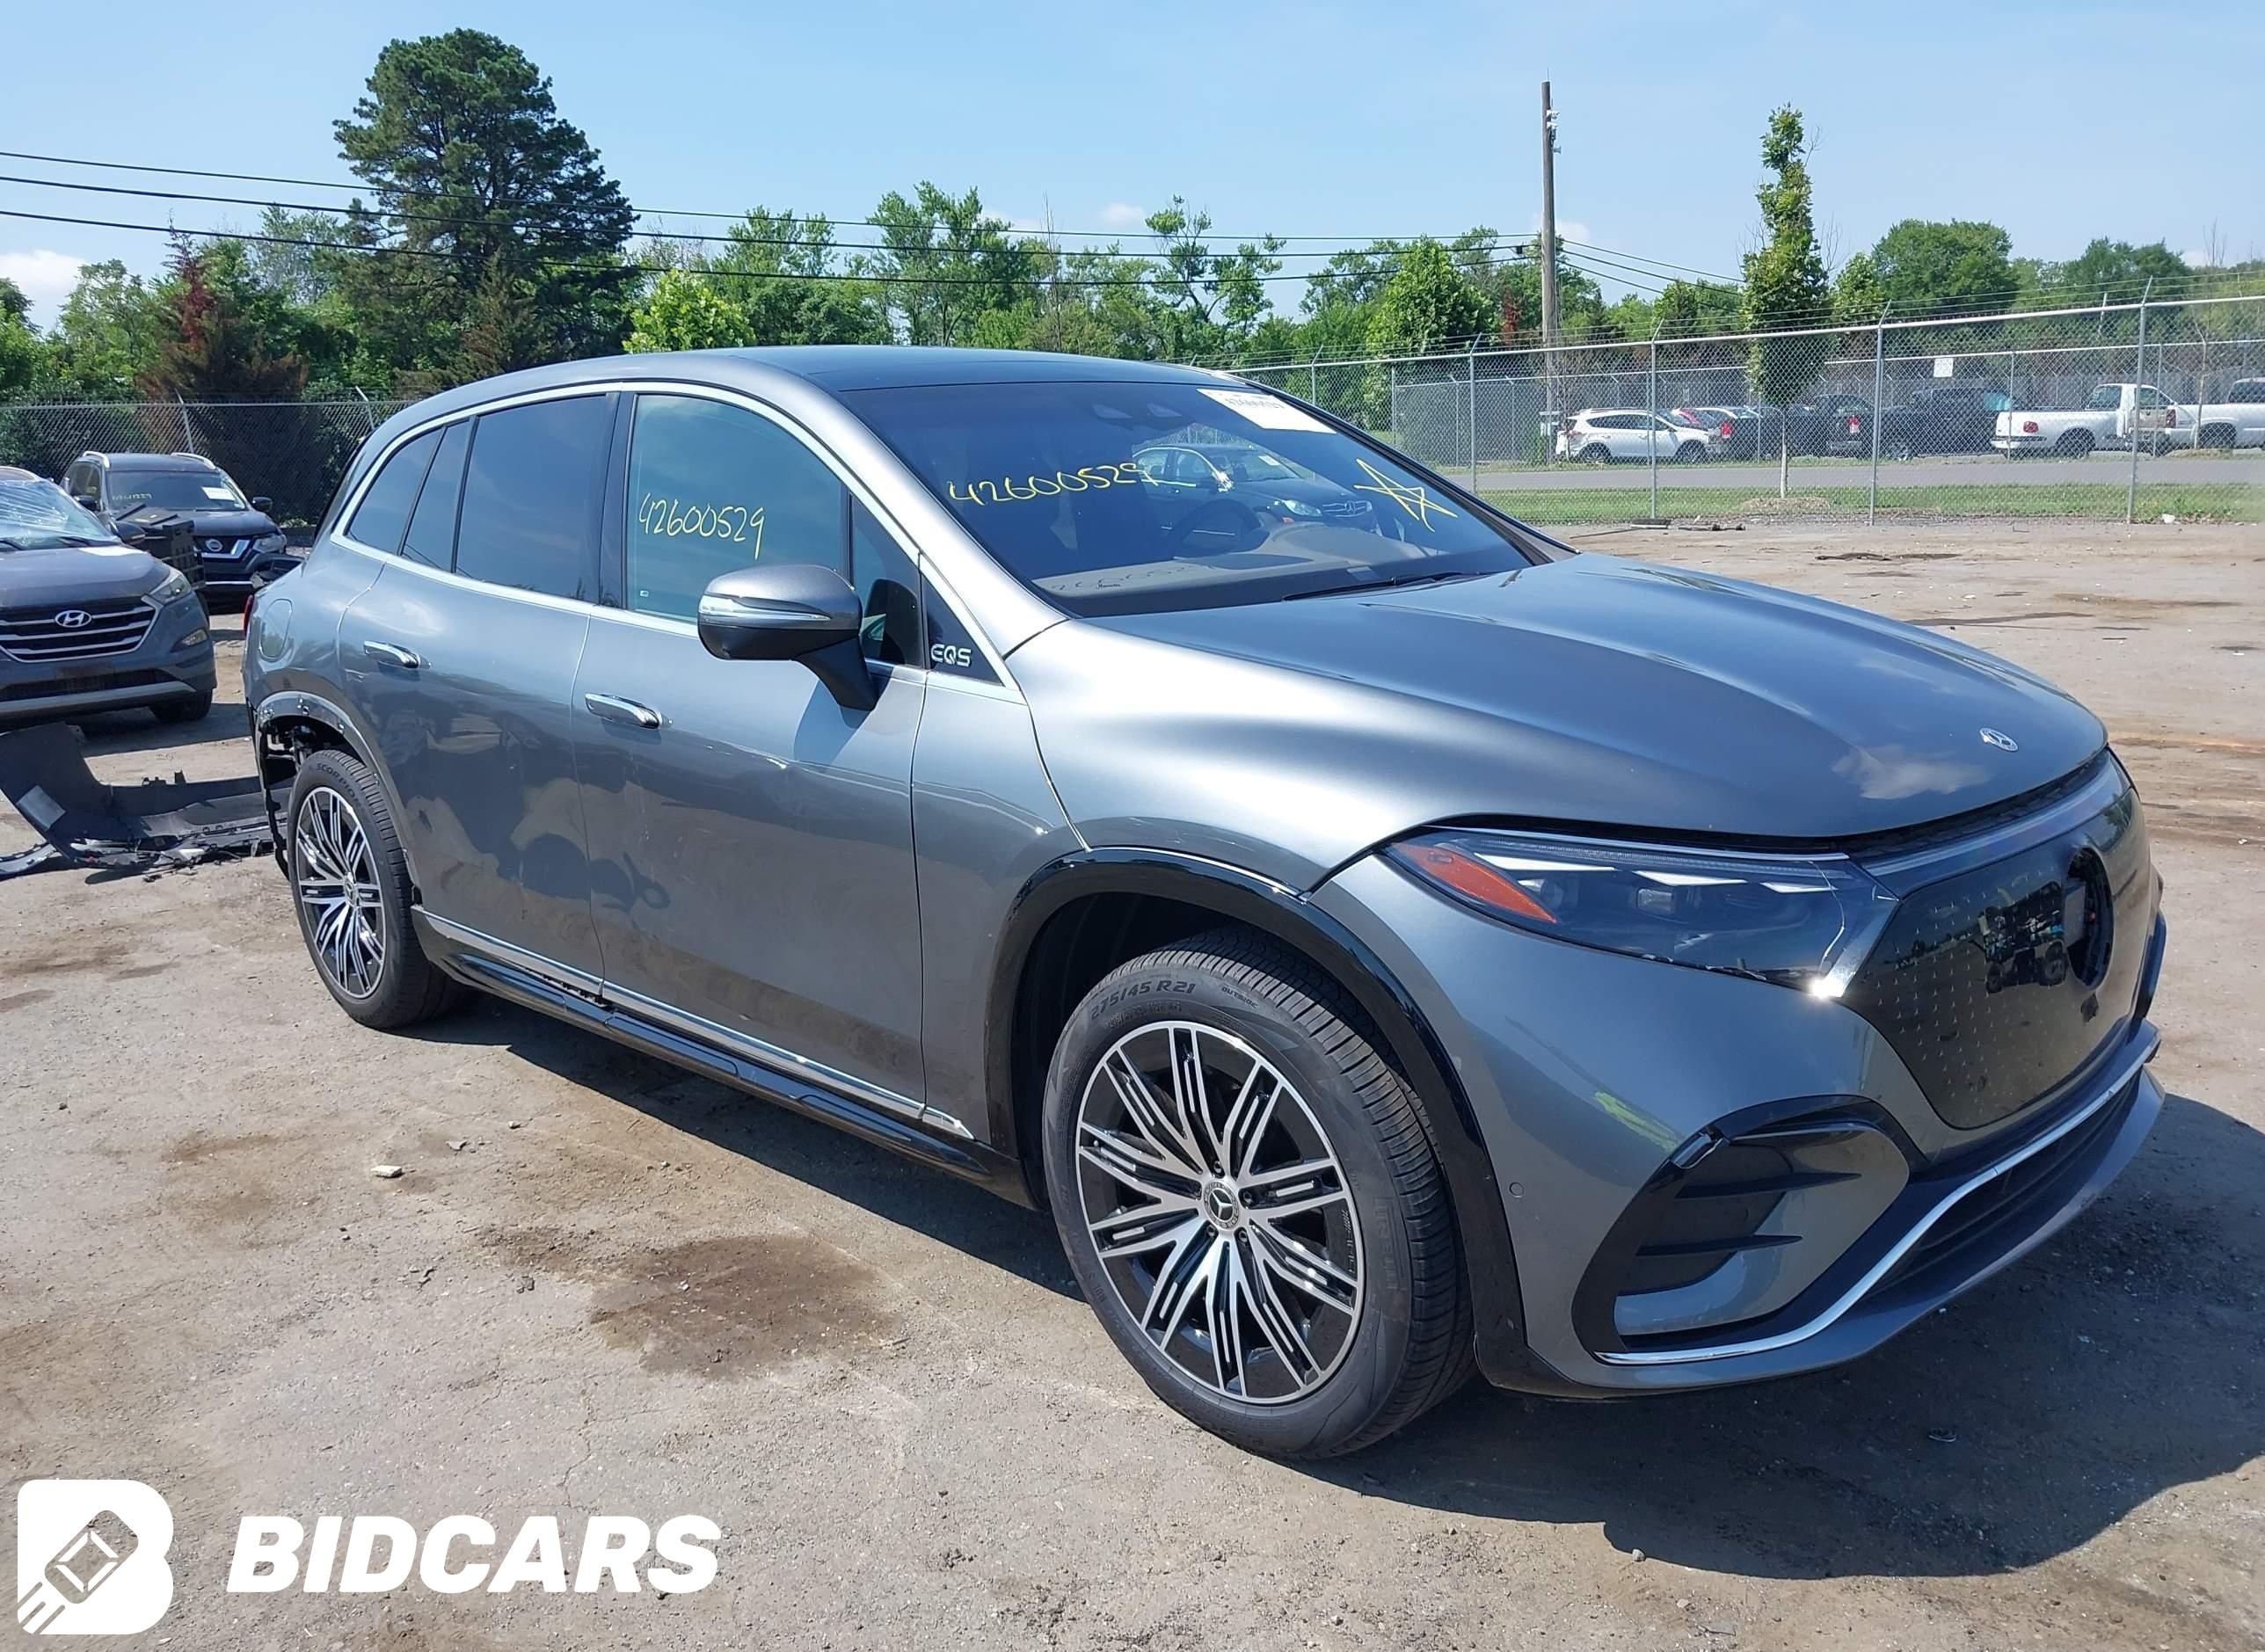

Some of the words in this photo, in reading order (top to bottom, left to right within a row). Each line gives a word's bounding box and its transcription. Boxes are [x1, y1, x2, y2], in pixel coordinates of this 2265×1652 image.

[947, 462, 1159, 506] 42600529
[638, 491, 765, 560] 42600529
[930, 643, 972, 667] EQS
[1089, 979, 1153, 1021] 275/45
[1155, 979, 1197, 994] R21
[1220, 984, 1259, 1008] OUTSIDE
